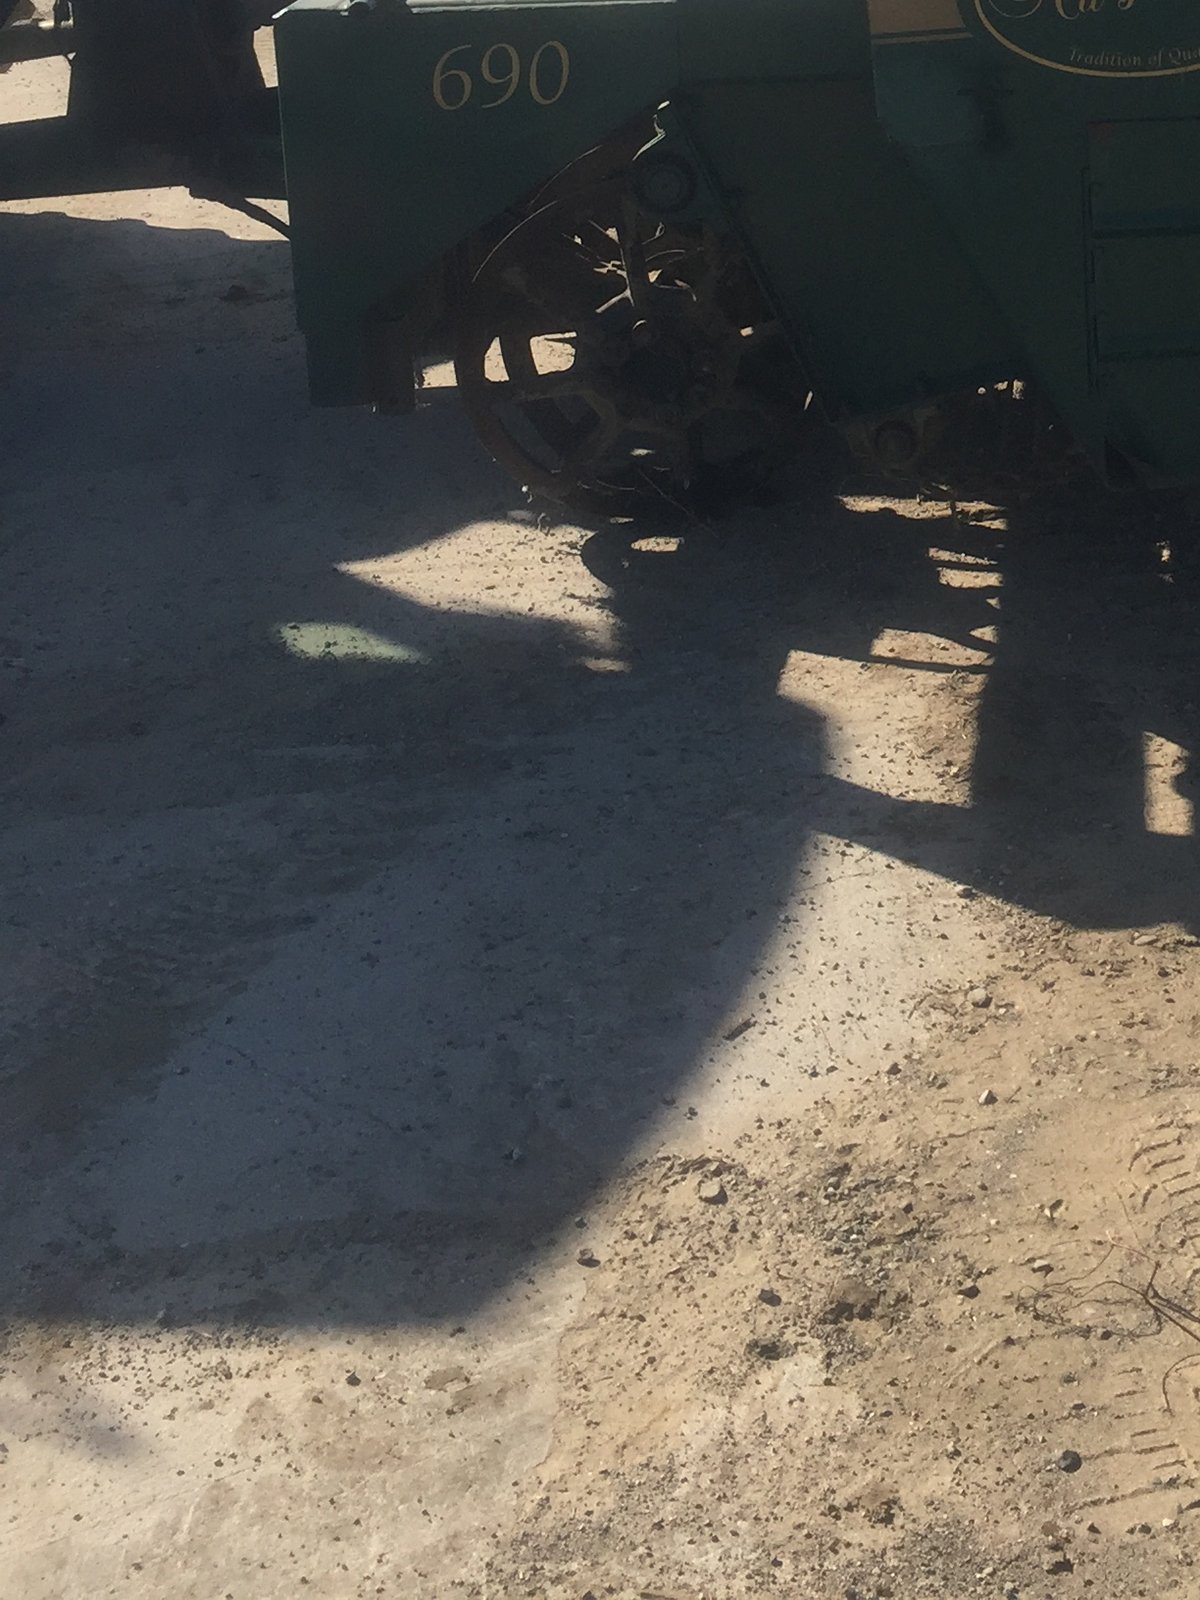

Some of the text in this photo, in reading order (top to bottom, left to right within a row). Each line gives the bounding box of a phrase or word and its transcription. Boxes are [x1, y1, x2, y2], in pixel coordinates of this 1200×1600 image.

[433, 41, 570, 111] 690
[1069, 47, 1142, 67] Tradition
[1147, 49, 1162, 67] of
